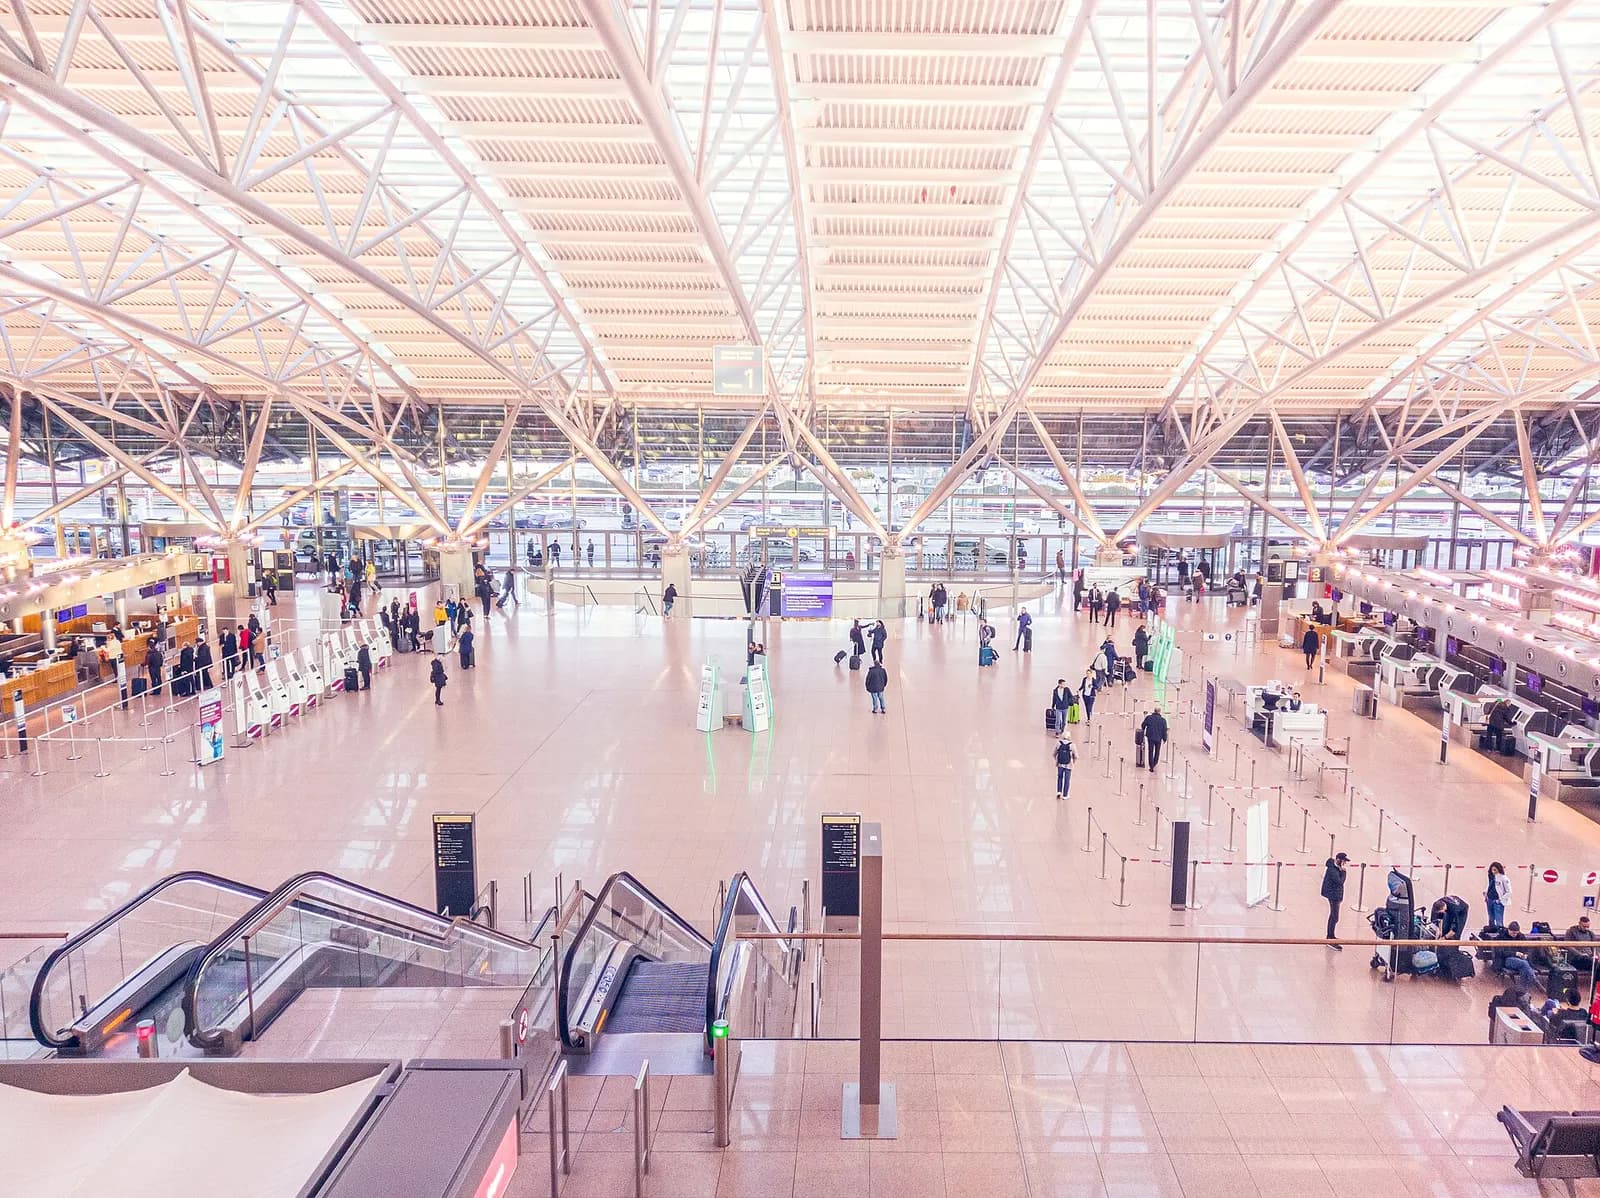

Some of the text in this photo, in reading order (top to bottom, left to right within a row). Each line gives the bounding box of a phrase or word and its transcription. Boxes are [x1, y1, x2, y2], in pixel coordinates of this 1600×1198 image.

[744, 368, 753, 389] 1
[195, 556, 203, 567] 2
[1312, 567, 1320, 578] 3
